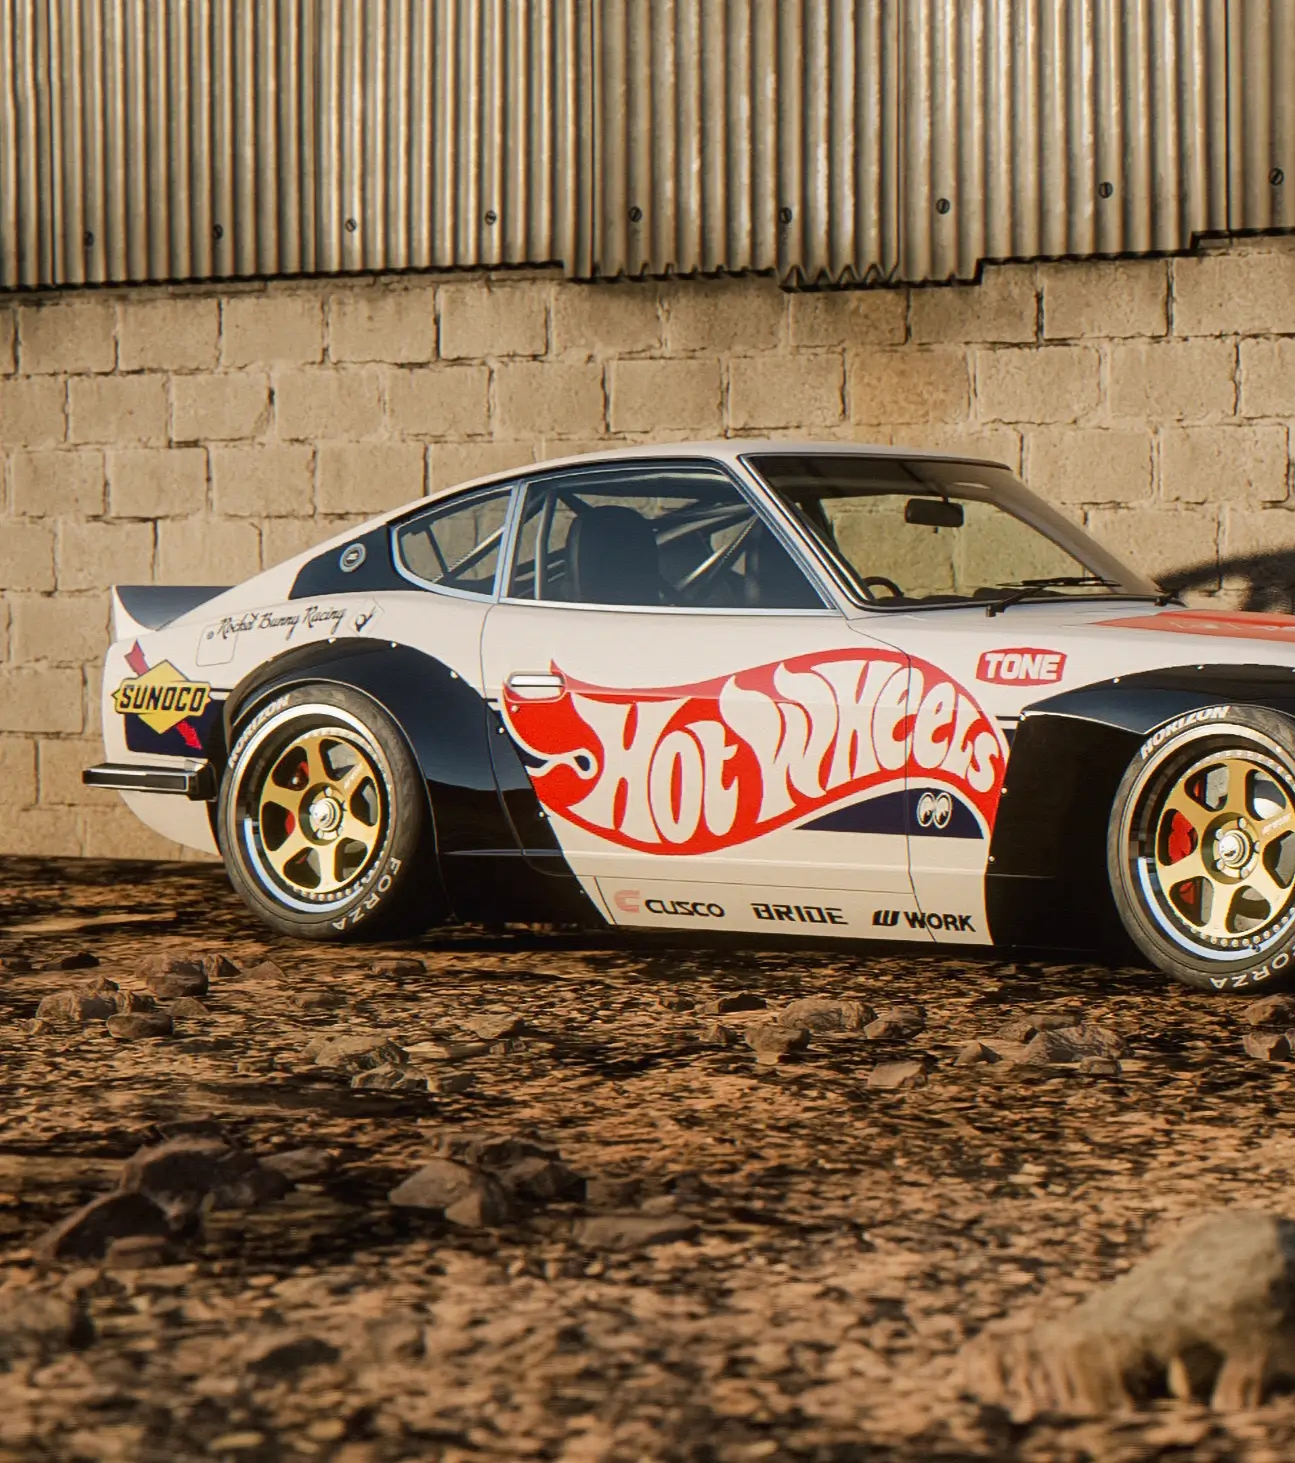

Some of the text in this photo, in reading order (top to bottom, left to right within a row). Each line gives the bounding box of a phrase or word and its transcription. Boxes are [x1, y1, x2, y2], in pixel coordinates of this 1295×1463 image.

[258, 613, 299, 640] Bunny
[302, 606, 347, 635] Racing
[985, 653, 1061, 680] TONE
[120, 685, 206, 712] SUNOCO
[228, 693, 291, 769] HORIZON
[1140, 706, 1230, 760] HORIZON
[332, 855, 401, 931] FORZA
[645, 899, 725, 918] CUSCO
[750, 902, 848, 925] BRIDE
[904, 910, 976, 932] WORK
